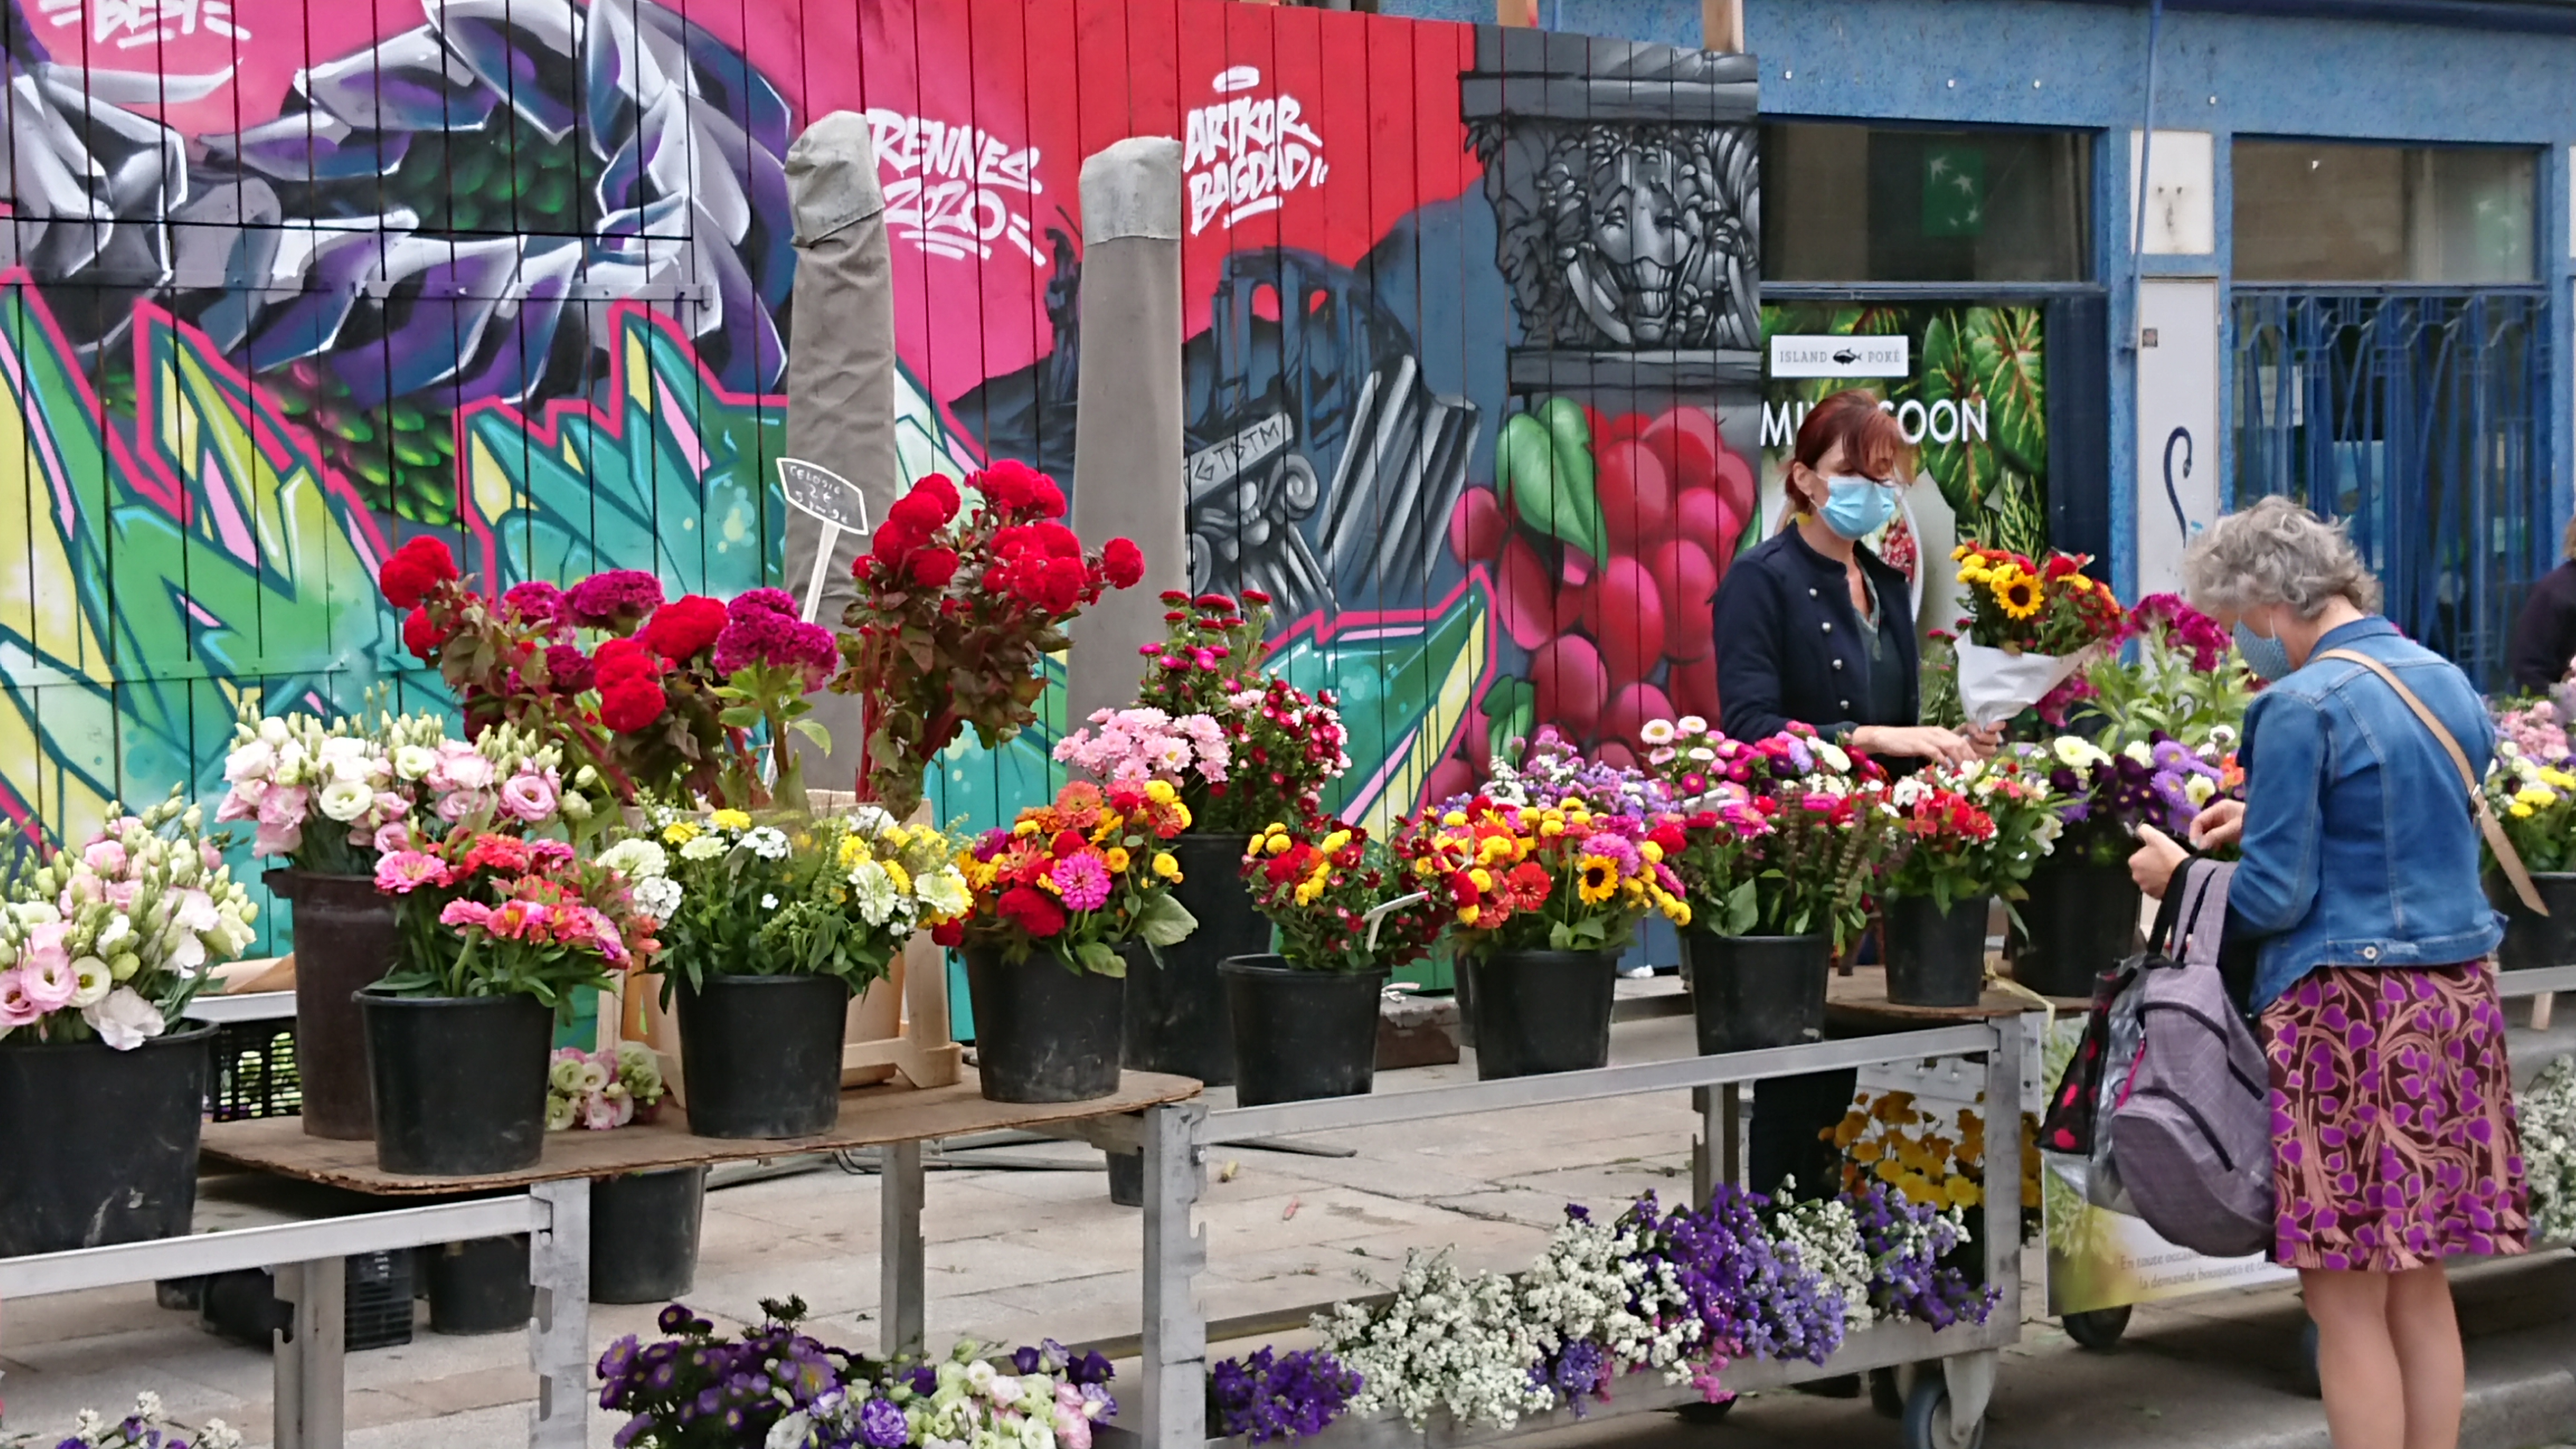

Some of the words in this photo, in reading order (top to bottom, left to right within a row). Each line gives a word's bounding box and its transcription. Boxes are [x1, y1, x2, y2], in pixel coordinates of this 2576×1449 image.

[866, 108, 1043, 194] RENNES
[1183, 95, 1323, 172] ARTKOR
[1189, 143, 1310, 236] BAGDAD
[1780, 351, 1827, 363] ISLAND
[1868, 349, 1900, 363] POKÉ
[1878, 399, 1987, 445] OON
[2121, 1255, 2134, 1269] En
[2137, 1255, 2164, 1268] toute
[2139, 1276, 2148, 1289] la
[2152, 1269, 2196, 1288] demande
[2198, 1264, 2242, 1281] bouquets
[2245, 1262, 2254, 1273] et
